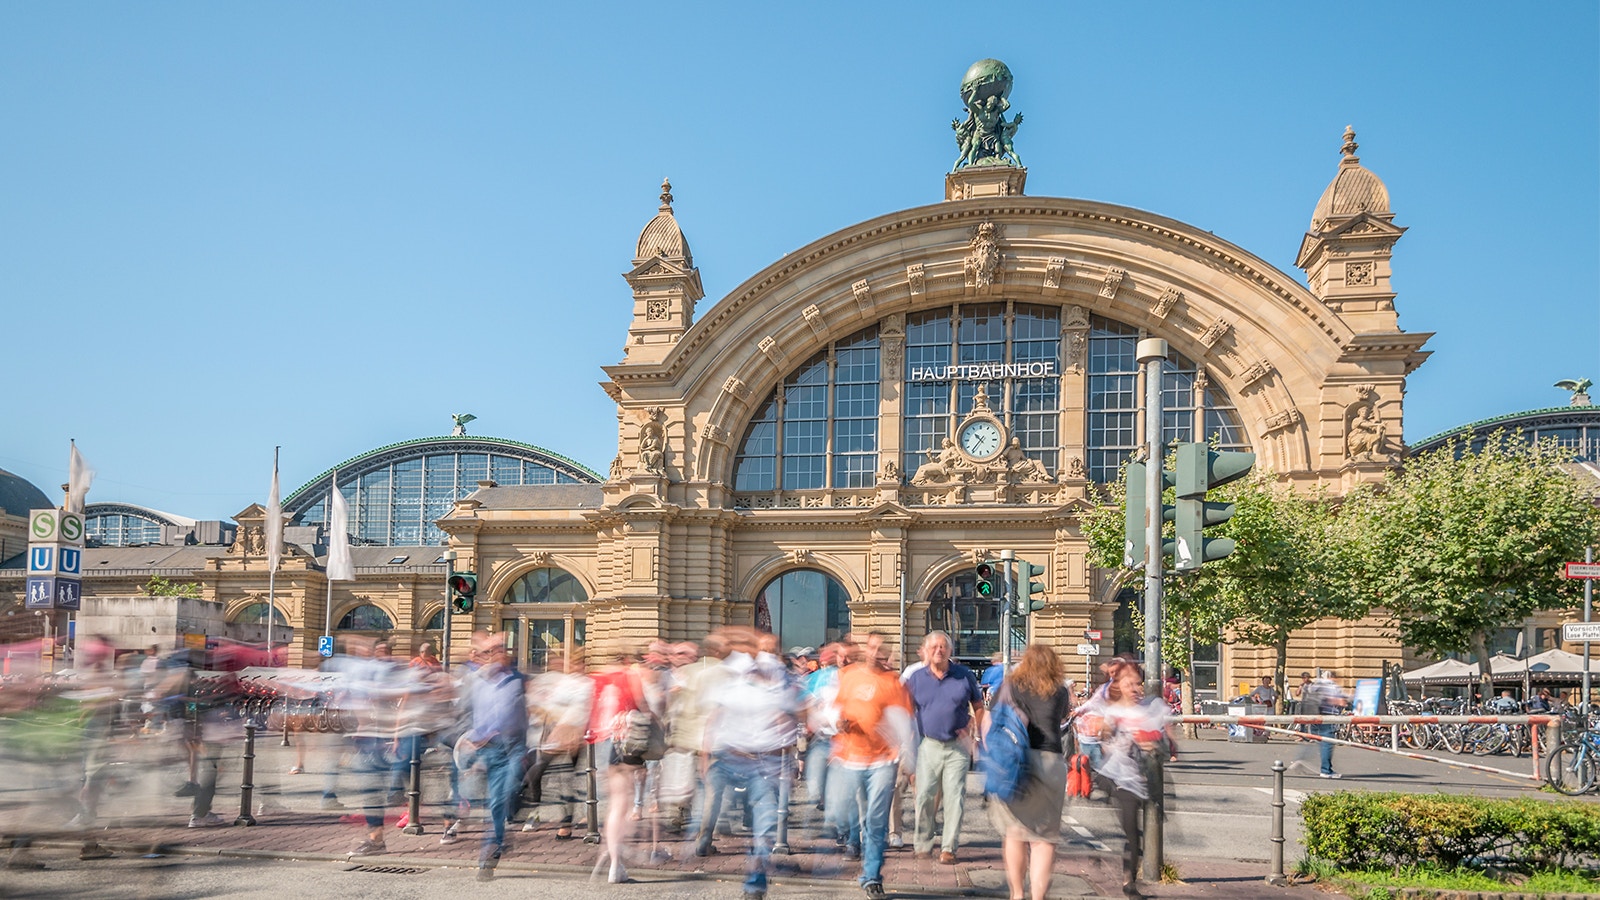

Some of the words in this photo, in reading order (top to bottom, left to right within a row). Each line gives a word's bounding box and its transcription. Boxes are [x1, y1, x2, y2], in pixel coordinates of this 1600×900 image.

[911, 361, 1055, 381] HAUPTBAHNHOF
[35, 514, 52, 537] S
[63, 516, 79, 539] S
[35, 549, 49, 569] U
[63, 551, 76, 571] U
[320, 638, 328, 649] P
